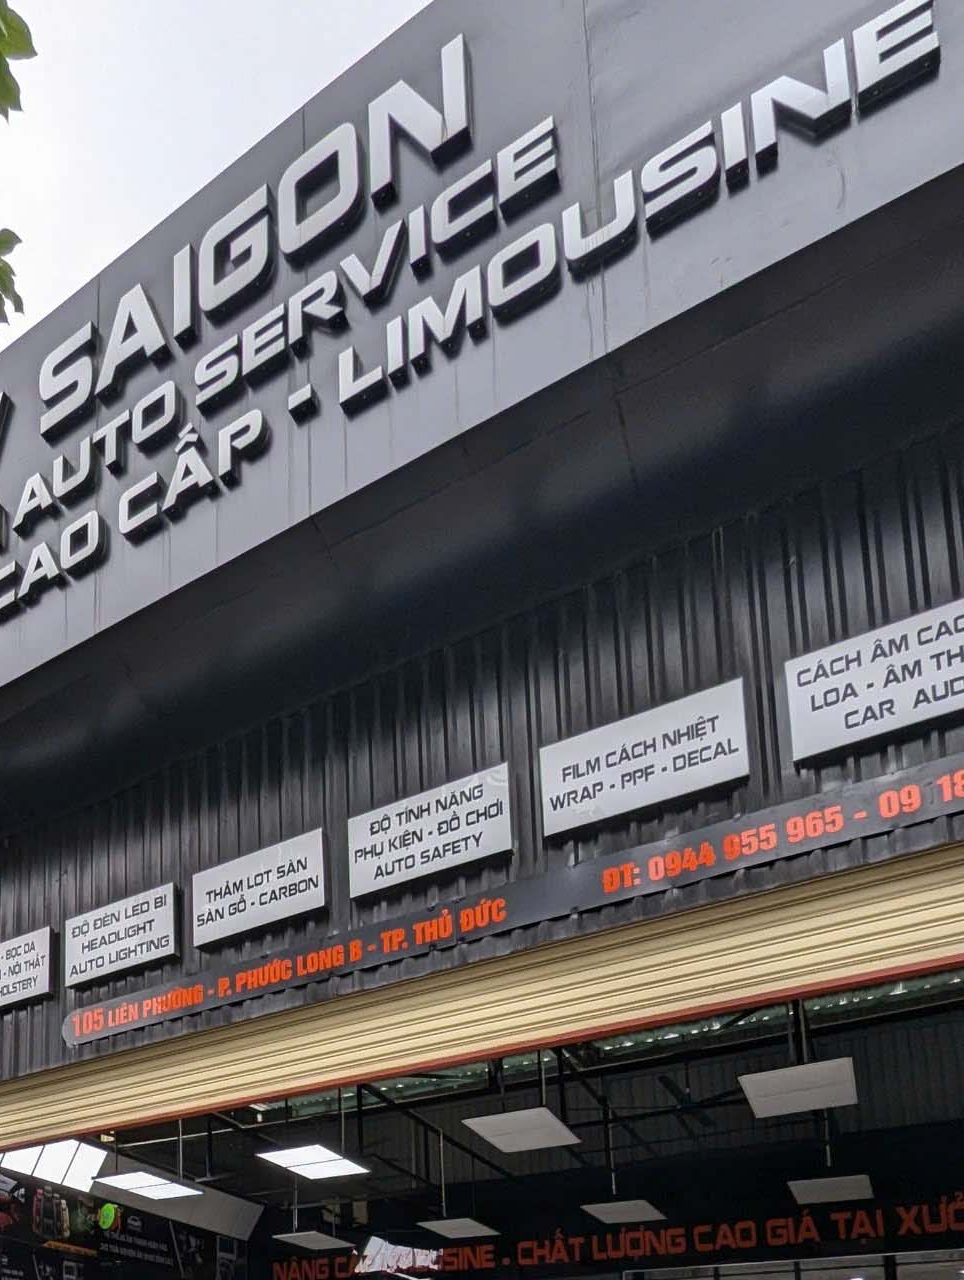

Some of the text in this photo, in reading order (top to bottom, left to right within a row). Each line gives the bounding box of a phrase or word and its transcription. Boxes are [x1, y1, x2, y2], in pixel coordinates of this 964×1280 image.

[39, 33, 472, 438] SAIGON
[118, 407, 270, 542] CẤP
[339, 0, 941, 413] LIMOUSINE
[13, 381, 184, 537] AUTO
[194, 116, 559, 412] SERVICE
[797, 634, 910, 687] CÁCH ÂM
[811, 659, 923, 712] LOA ÂM
[844, 699, 896, 729] CAR
[549, 738, 739, 812] WRAP PPF DECAL
[561, 715, 719, 783] FILM CÁCH NHIỆT
[353, 802, 503, 865] PHỤ KIỆN ĐỒ CHƠI
[369, 783, 484, 836] ĐỘ TÍNH NĂNG
[648, 784, 921, 881] 0944 955 965 09
[205, 879, 243, 903] THẢM
[276, 857, 308, 879] SÀN
[373, 832, 484, 880] AUTO SAFETY
[71, 894, 167, 939] ĐỘ ĐÈN LED BI
[196, 907, 224, 927] SÀN
[258, 875, 319, 906] CARBON
[24, 940, 36, 954] DA
[70, 935, 170, 977] AUTO LIGHTING
[81, 919, 155, 954] HEADLIGHT
[71, 1007, 105, 1038] 105
[297, 944, 344, 976] LONG
[349, 939, 363, 962] B
[381, 927, 408, 953] TP.
[413, 908, 453, 945] THỦ
[460, 897, 508, 932] ĐỨC
[517, 1228, 585, 1266] CHẤT
[591, 1223, 686, 1262] LƯỢNG
[693, 1220, 757, 1252] CAO
[767, 1208, 820, 1245] GIÁ
[830, 1208, 884, 1244] TẠI
